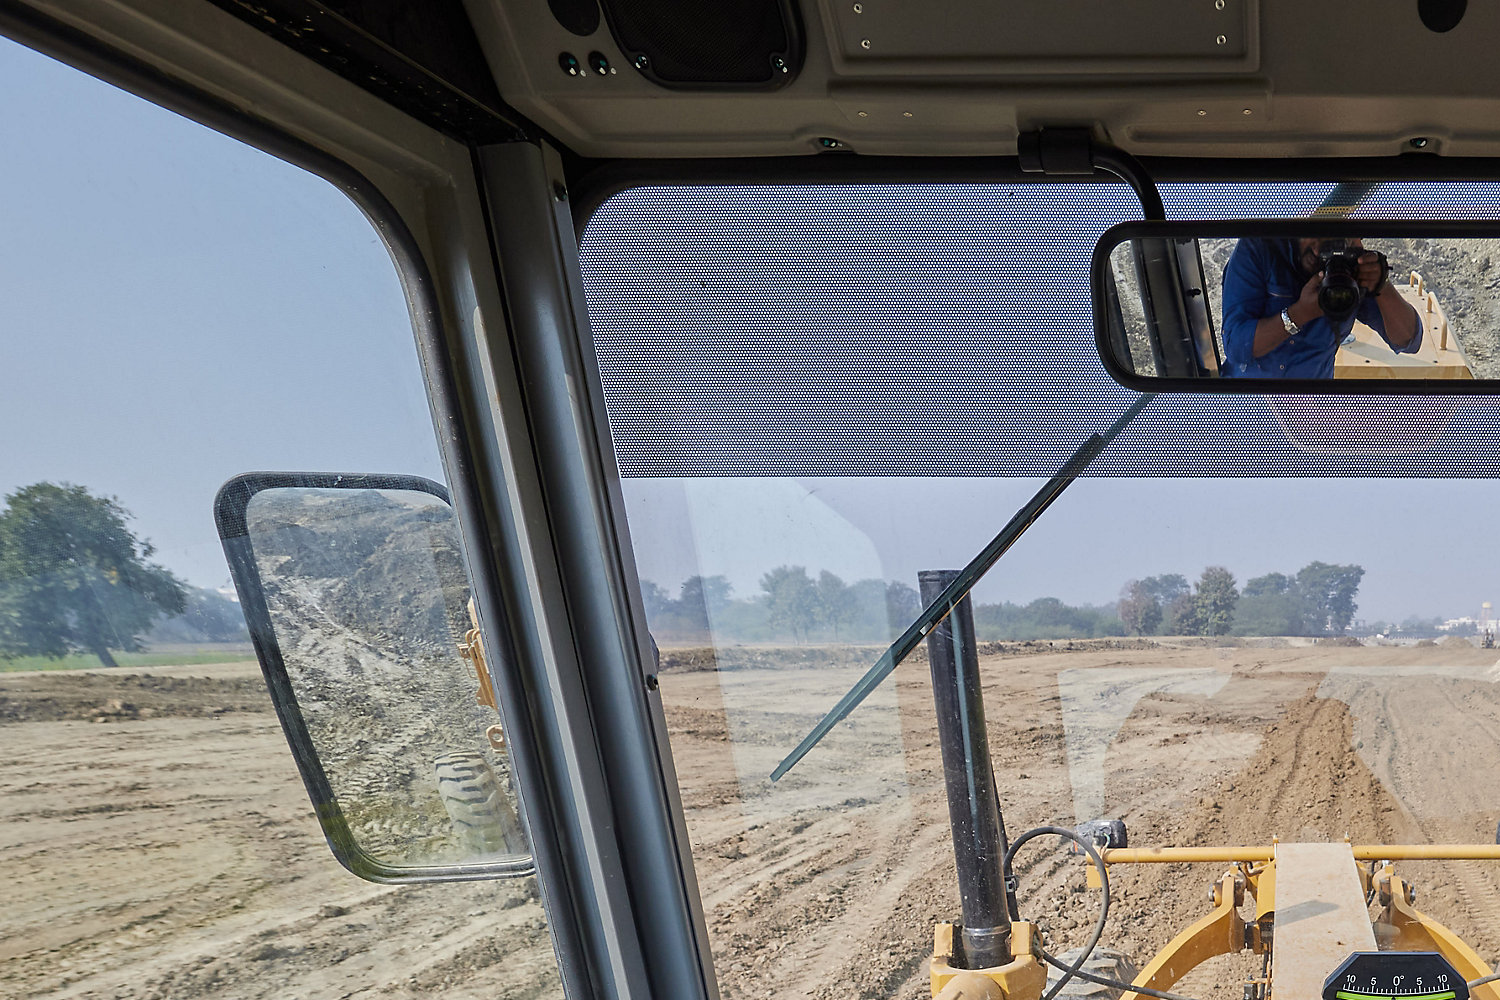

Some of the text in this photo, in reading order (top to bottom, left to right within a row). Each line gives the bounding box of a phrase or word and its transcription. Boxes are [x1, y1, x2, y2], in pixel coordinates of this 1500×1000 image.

[1346, 974, 1357, 984] 10
[1370, 977, 1377, 986] 5
[1416, 977, 1423, 985] 5
[1437, 974, 1448, 983] 10
